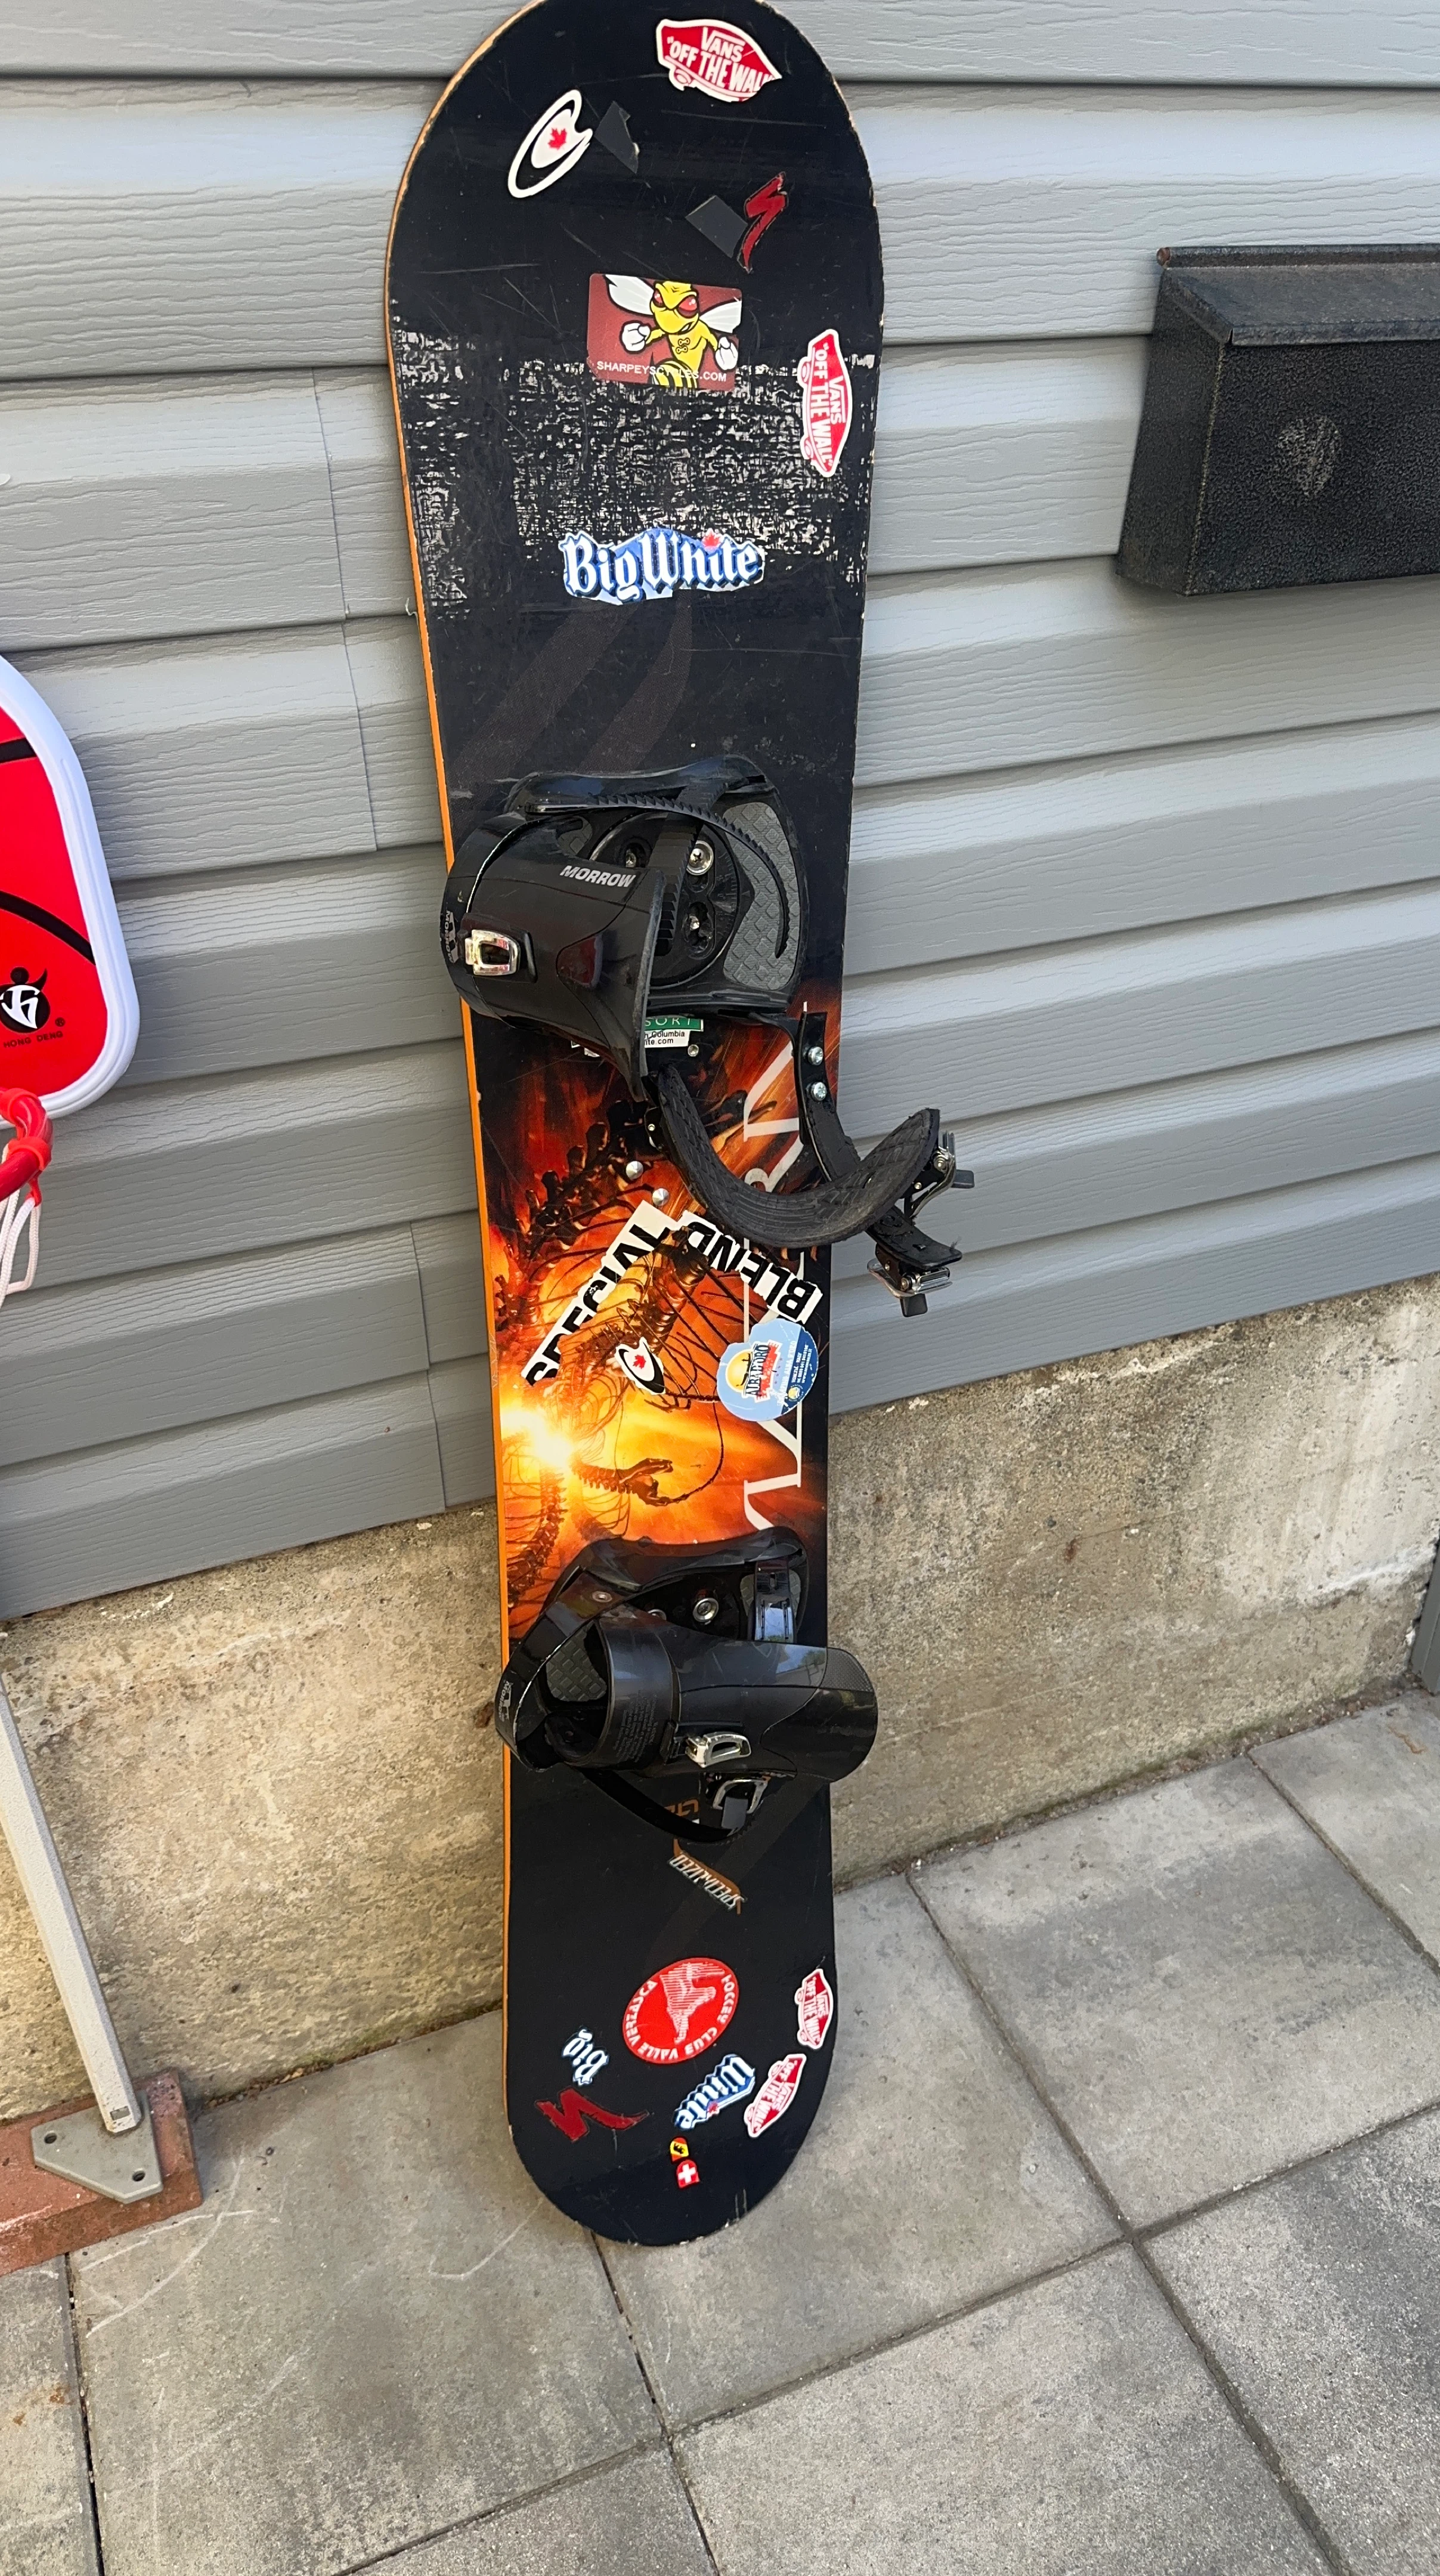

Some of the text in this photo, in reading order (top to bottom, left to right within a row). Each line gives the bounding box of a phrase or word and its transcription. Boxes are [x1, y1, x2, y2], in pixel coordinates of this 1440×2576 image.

[701, 26, 745, 63] VANS
[698, 51, 732, 88] THE
[596, 361, 727, 382] SHARPEYSCYCLES.COM
[810, 382, 831, 419] THE
[829, 375, 846, 425] VANS
[559, 865, 636, 887] MORROW
[444, 910, 454, 964] MORROW
[3, 1030, 63, 1048] HONG DENG
[651, 1030, 685, 1038] Columbia
[688, 1221, 817, 1321] BLEND
[668, 1854, 747, 1911] SPECIALIZED
[804, 1996, 817, 2020] THE
[816, 1989, 829, 2018] VANS
[637, 2042, 679, 2060] VALLE
[685, 2027, 717, 2055] CLUB
[563, 2029, 609, 2084] Big
[761, 2079, 785, 2103] THE
[771, 2082, 795, 2111] VANS
